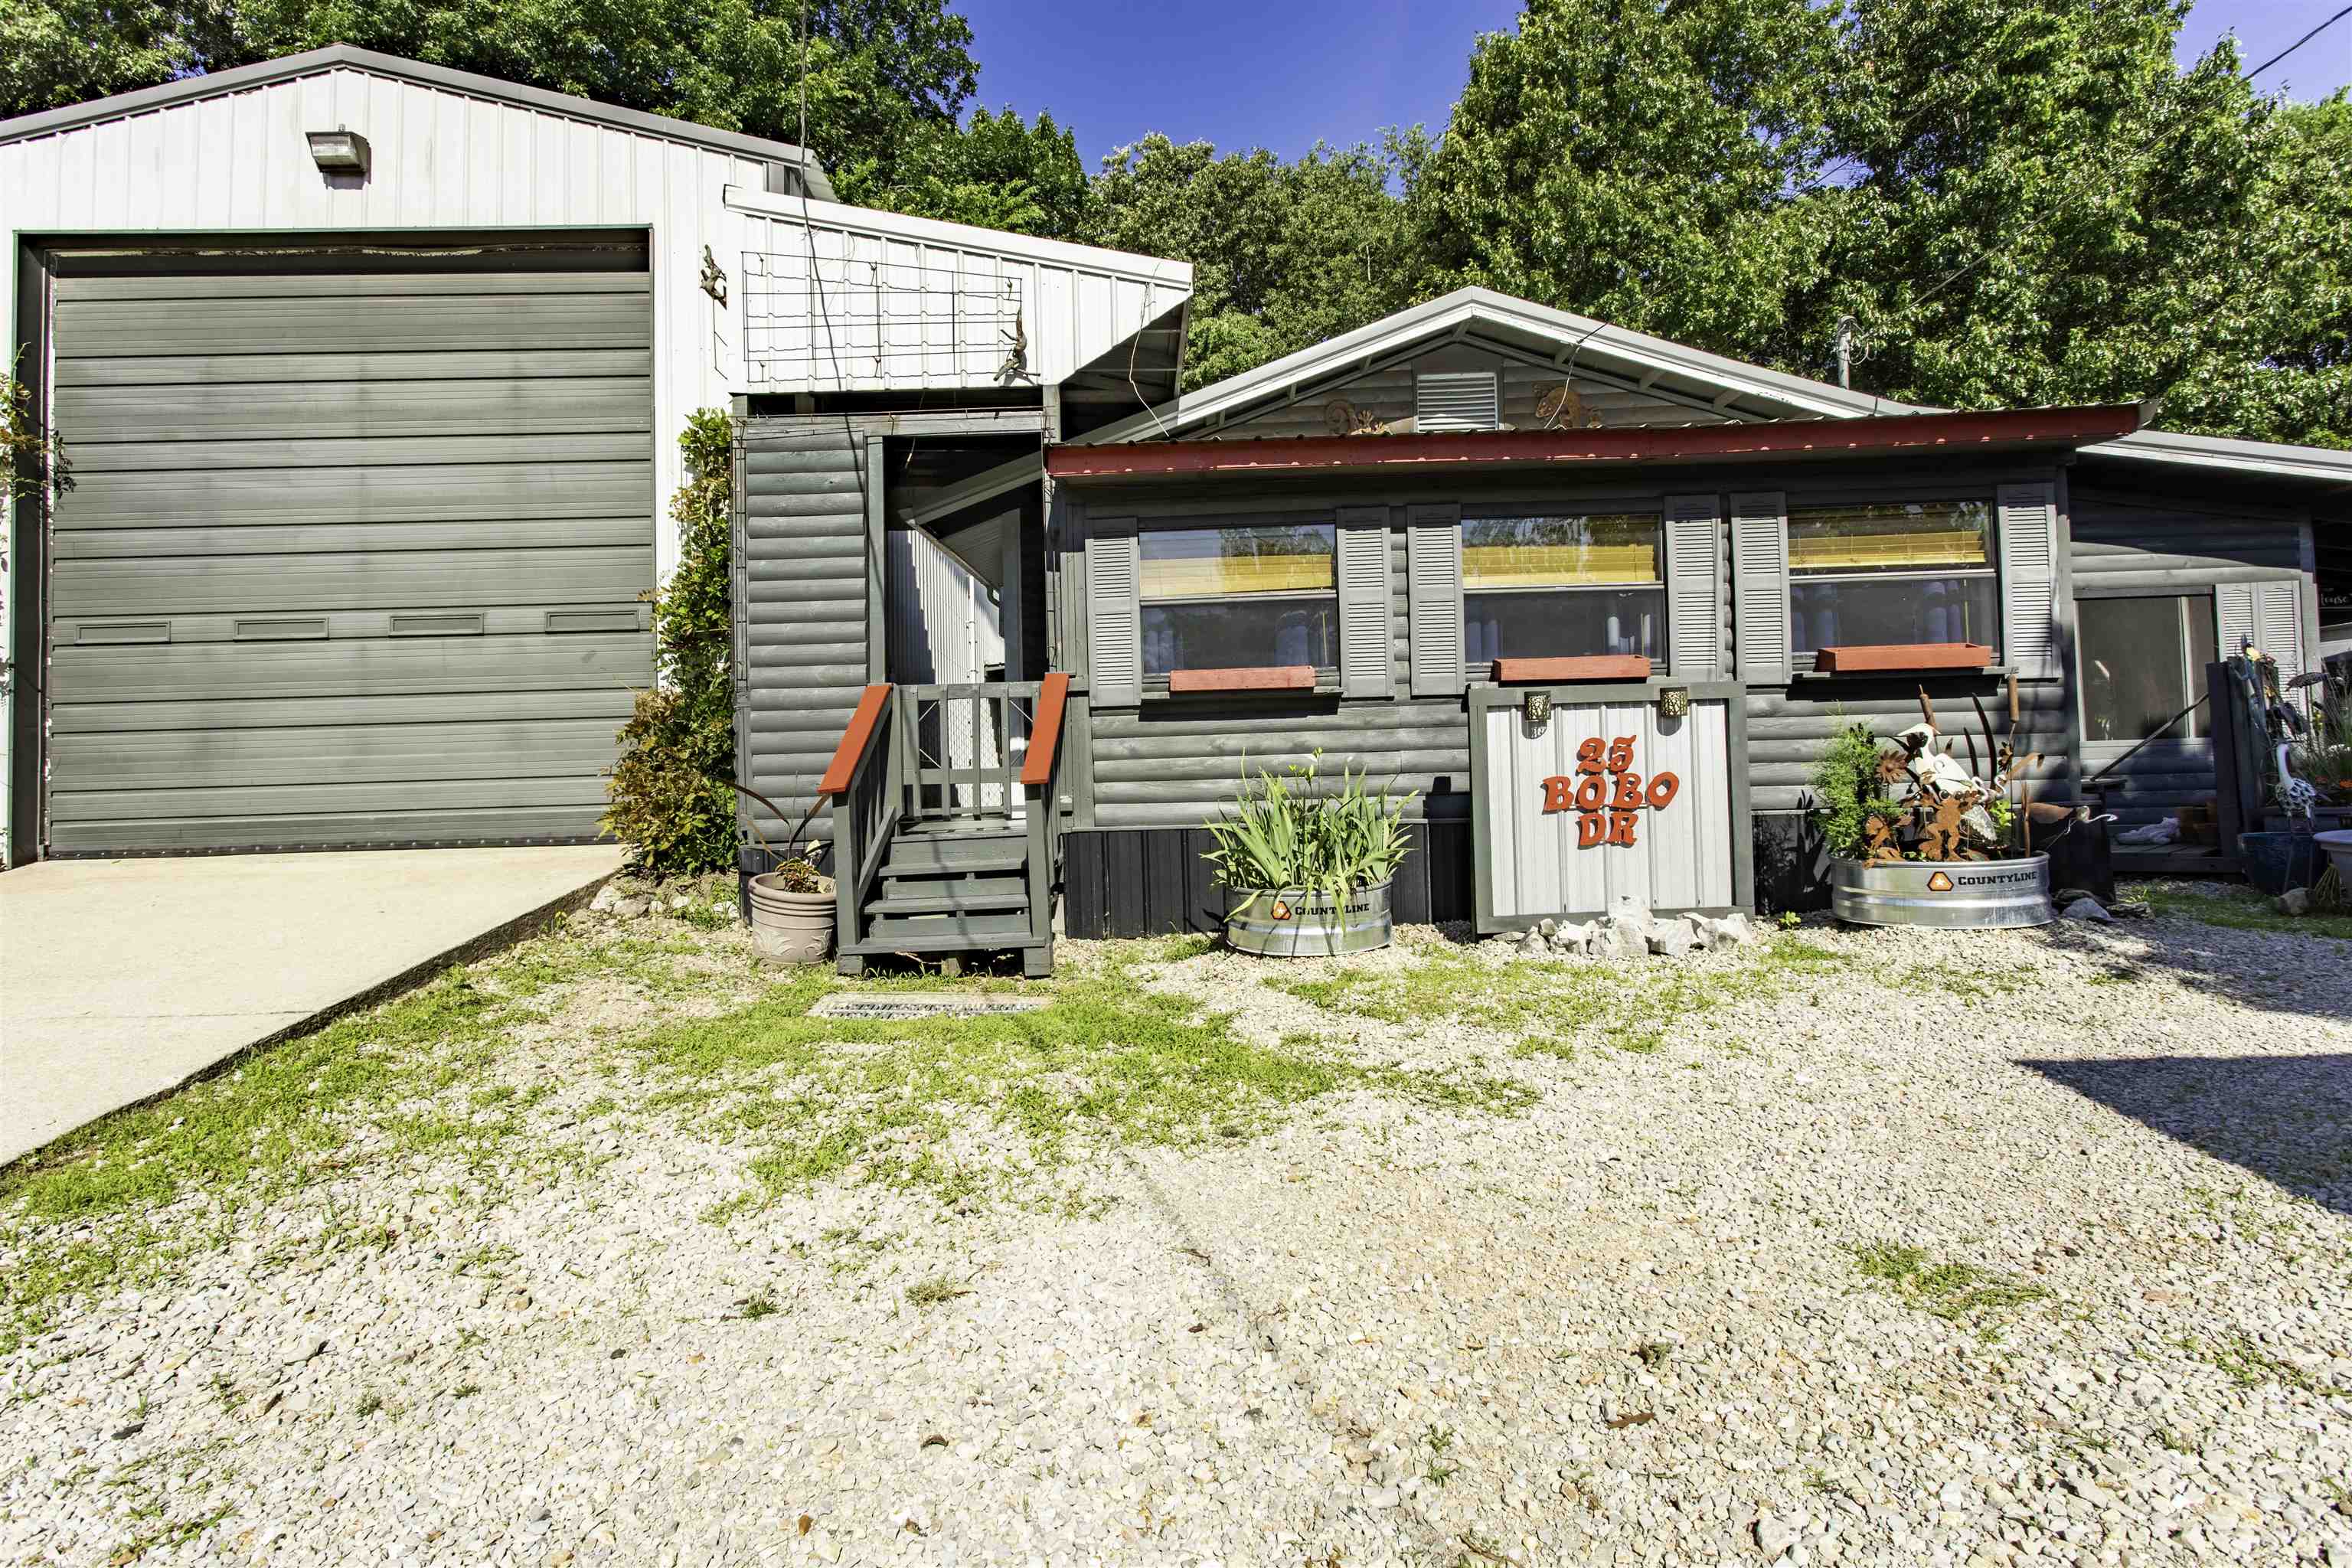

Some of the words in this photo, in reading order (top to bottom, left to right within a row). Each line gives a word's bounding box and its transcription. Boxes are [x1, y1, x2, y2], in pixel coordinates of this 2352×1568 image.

[1576, 735, 1637, 773] 25
[1541, 771, 1680, 812] BOBO
[1577, 811, 1638, 847] DR
[1958, 871, 2037, 885] COUNTYLINE
[1295, 903, 1370, 916] CUNTLINE
